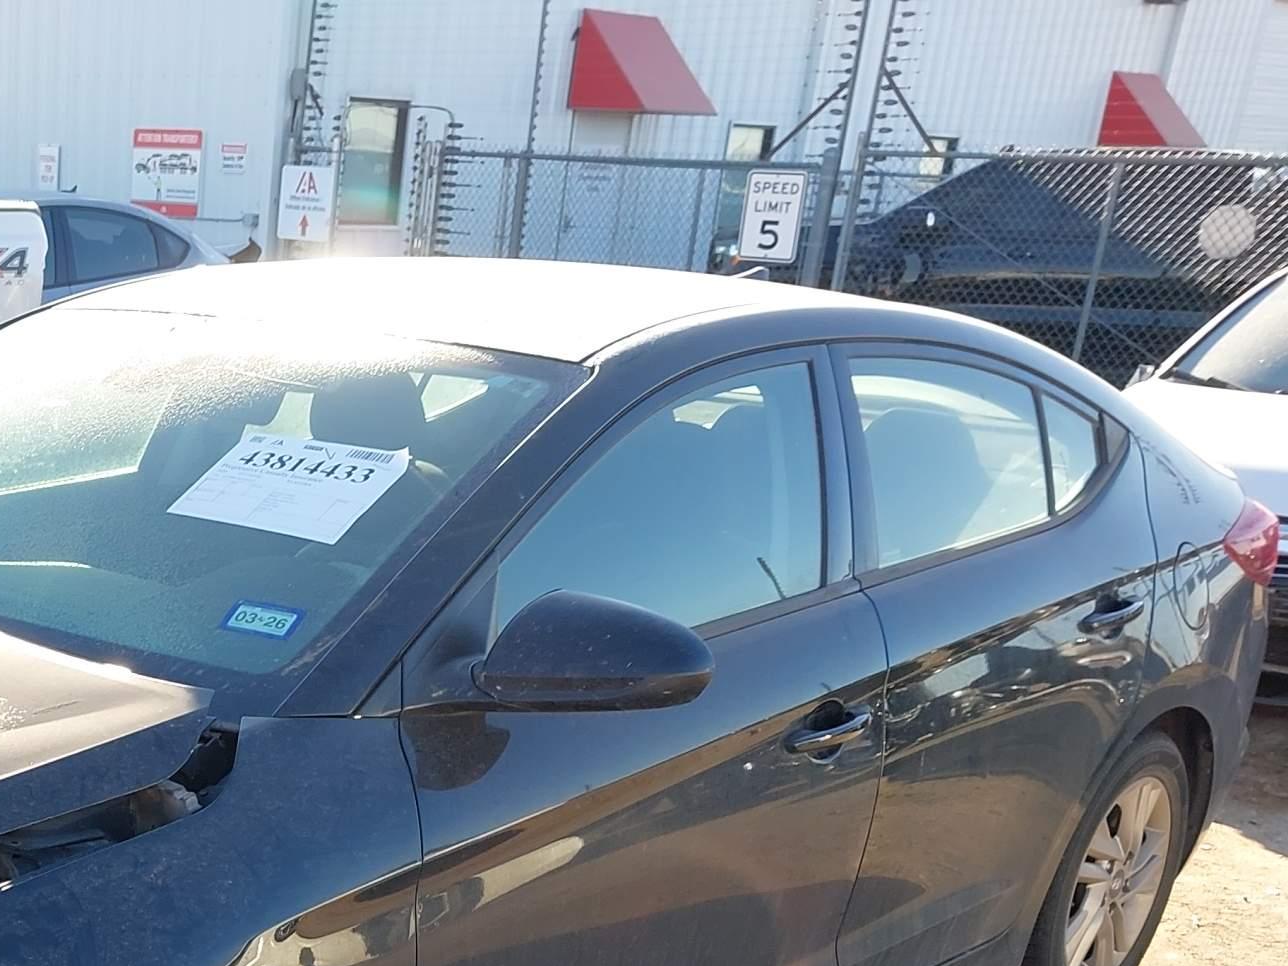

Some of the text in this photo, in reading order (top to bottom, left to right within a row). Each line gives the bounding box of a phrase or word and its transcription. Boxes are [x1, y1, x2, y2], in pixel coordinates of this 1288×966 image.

[753, 181, 800, 196] SPEED
[754, 200, 792, 214] LIMIT
[757, 220, 779, 250] 5
[239, 450, 376, 484] 43814433
[234, 610, 288, 630] 03-26
